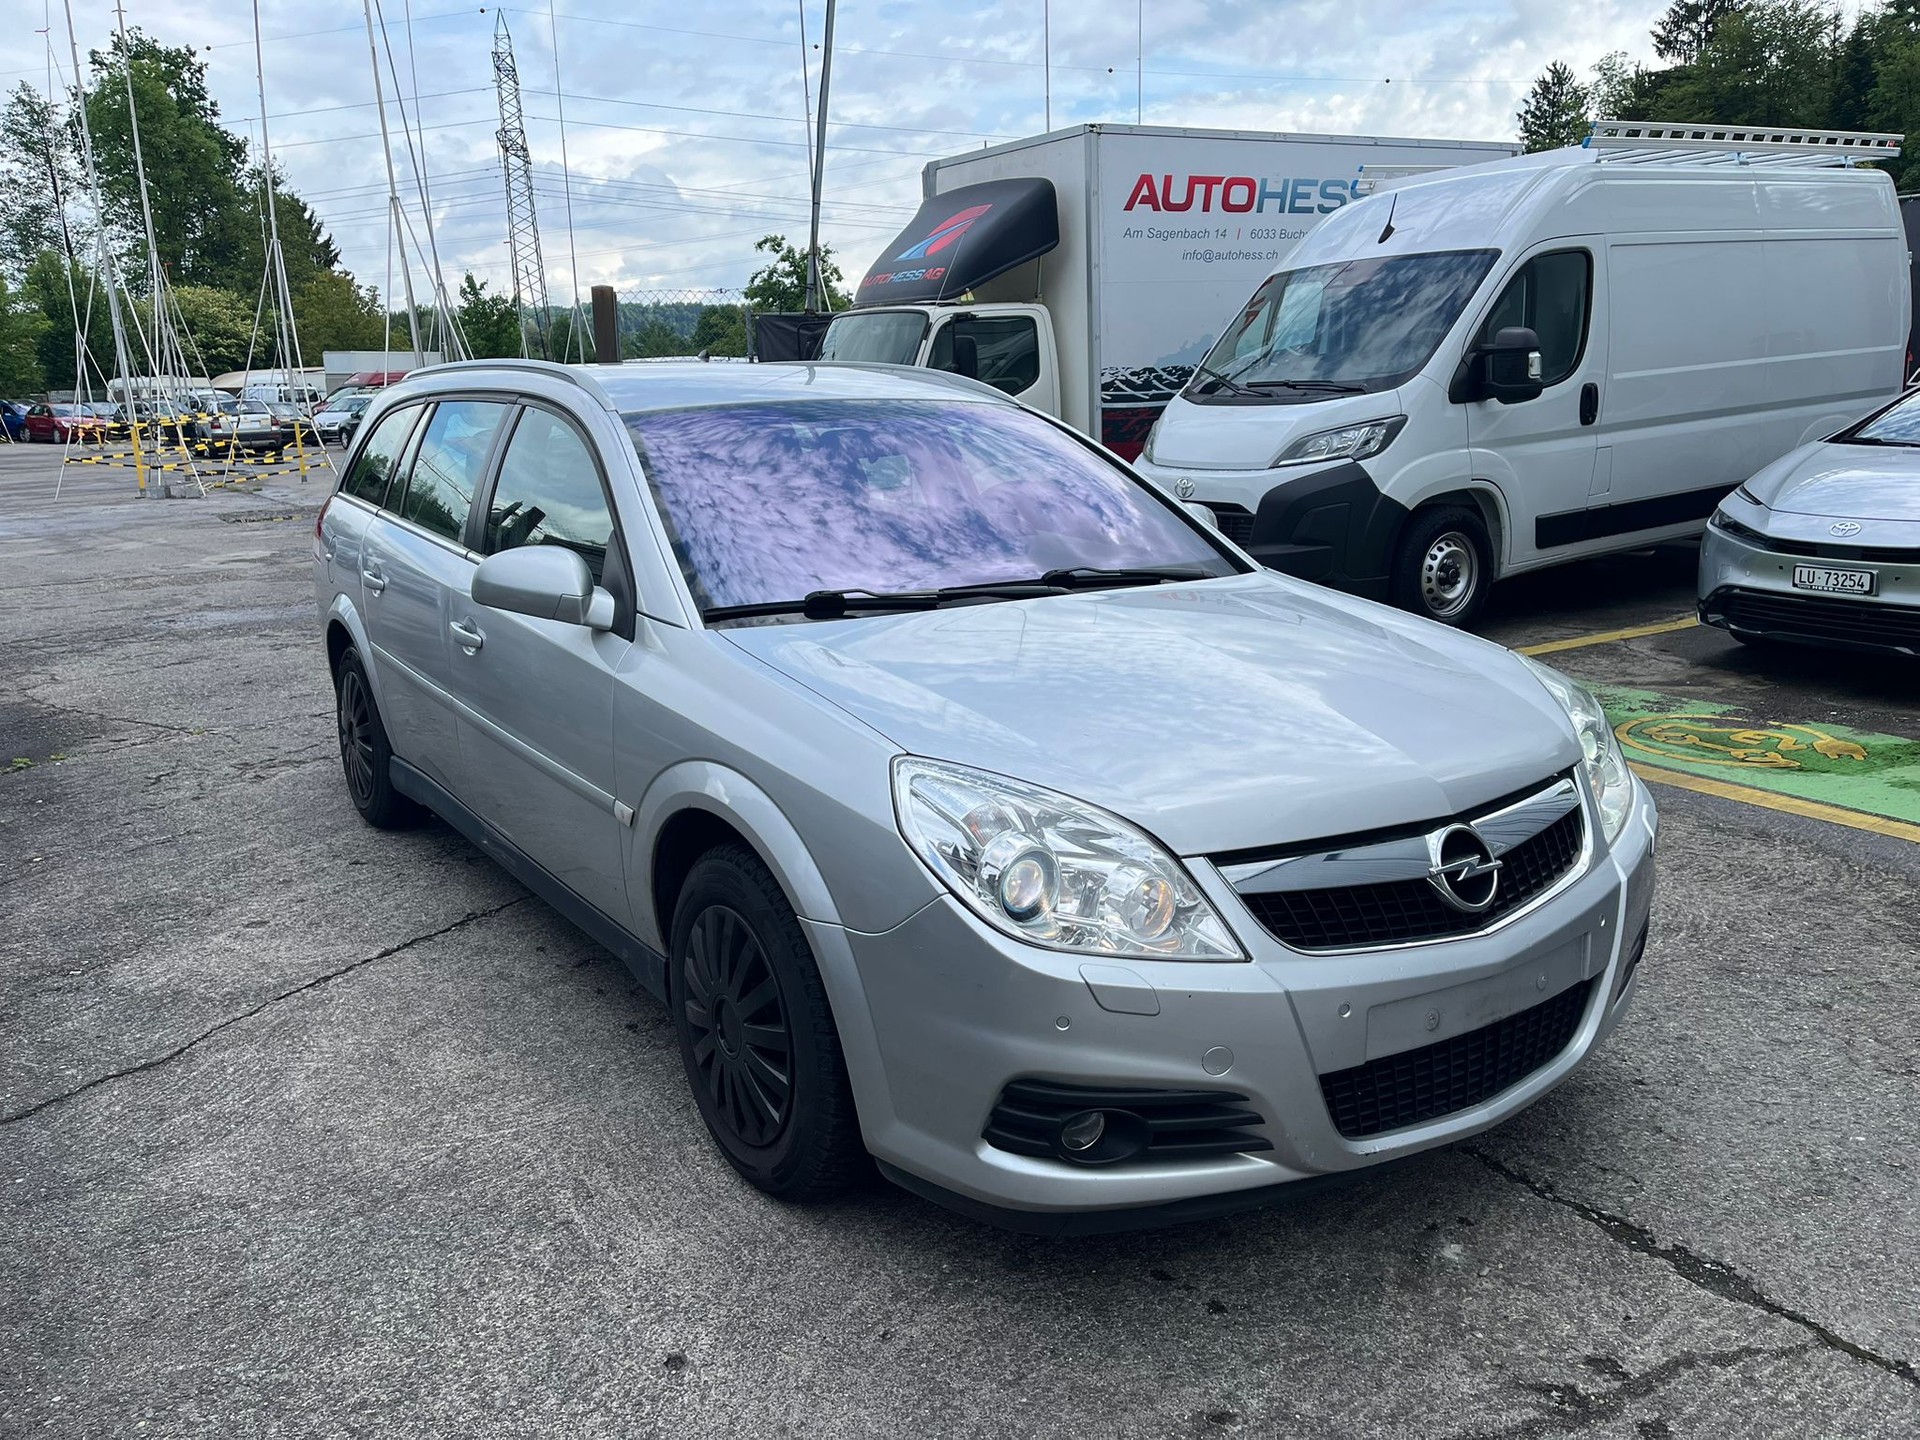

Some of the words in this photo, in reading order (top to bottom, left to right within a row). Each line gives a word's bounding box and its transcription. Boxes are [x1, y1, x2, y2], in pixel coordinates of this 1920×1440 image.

[1123, 173, 1369, 214] AUTOHES
[1123, 228, 1144, 239] Am
[1147, 228, 1210, 241] Sagenbach
[1214, 229, 1228, 239] 14
[1249, 229, 1277, 239] 6033
[1279, 228, 1308, 240] Buch
[1182, 249, 1279, 263] info@autohess.ch
